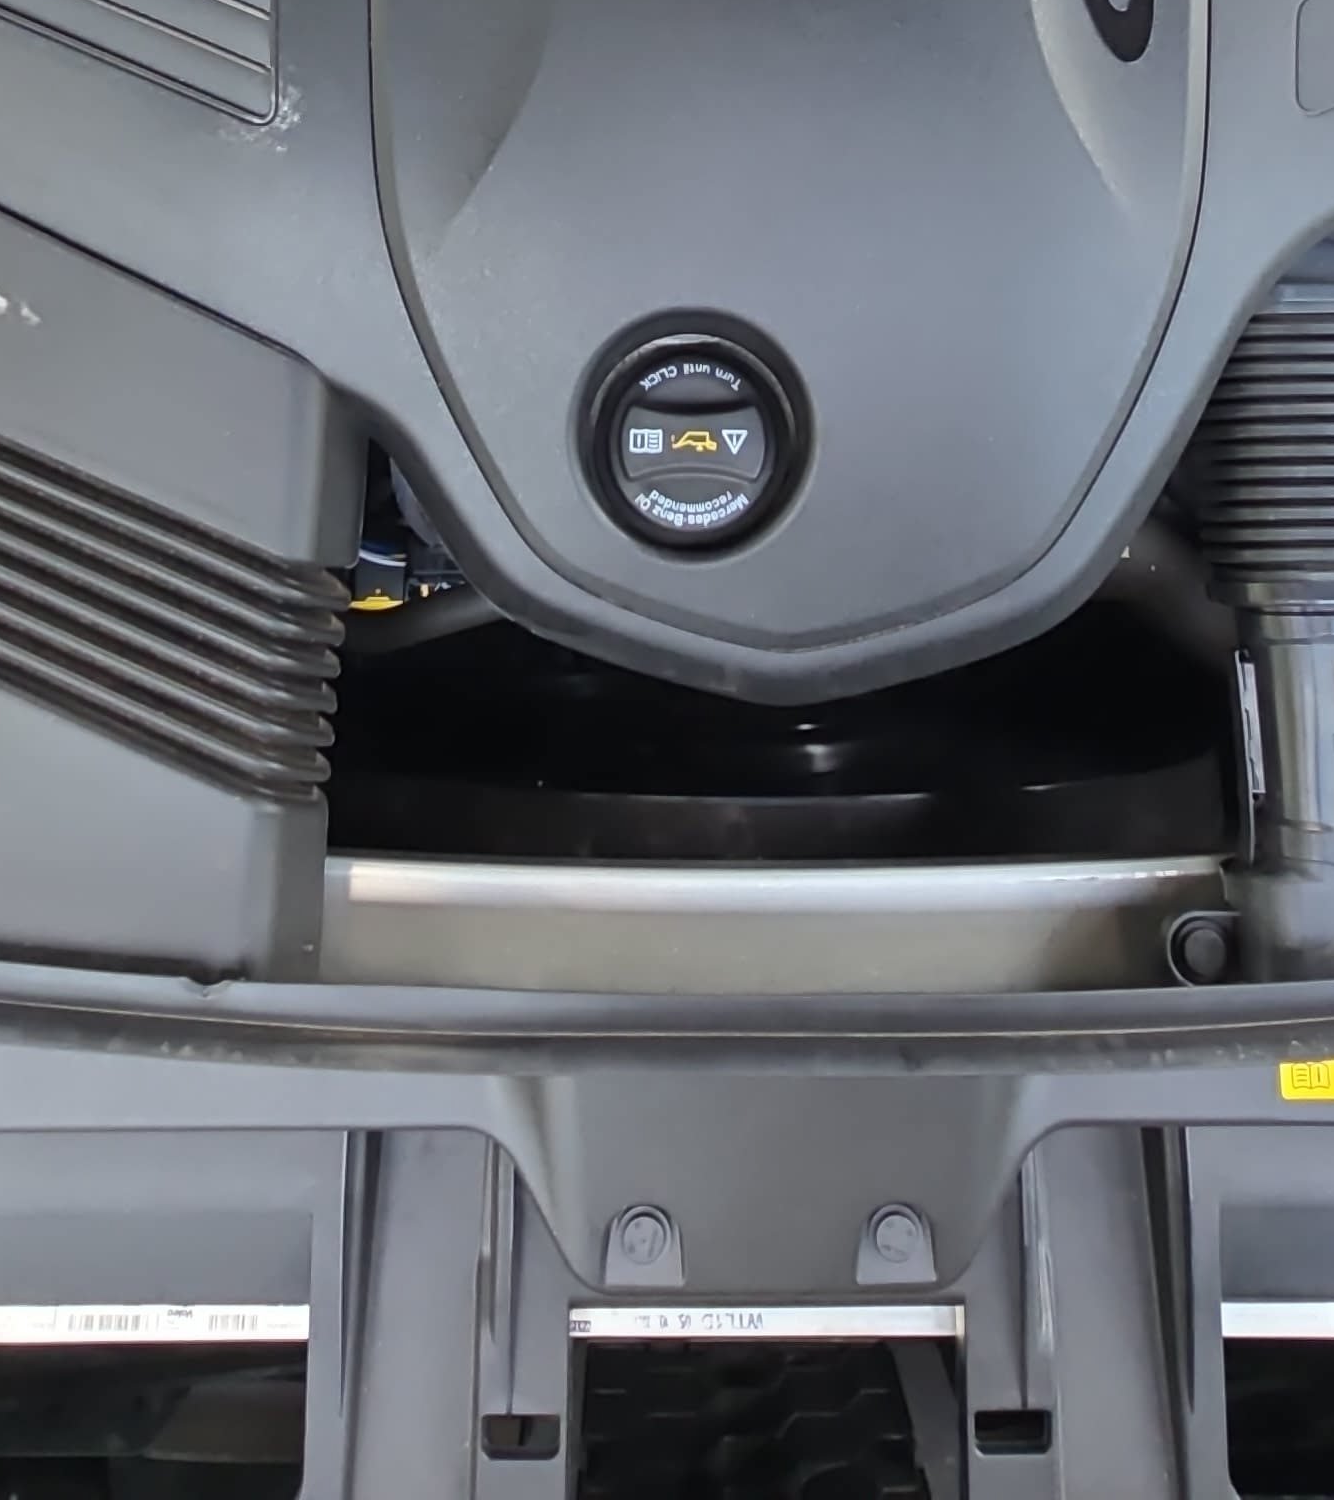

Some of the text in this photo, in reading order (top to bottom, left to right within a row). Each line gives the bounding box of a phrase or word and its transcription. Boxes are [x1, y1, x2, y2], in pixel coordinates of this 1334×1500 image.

[639, 363, 742, 391] Turn until CLICK
[649, 490, 733, 513] recommended
[652, 493, 749, 527] Mercedes-Benz
